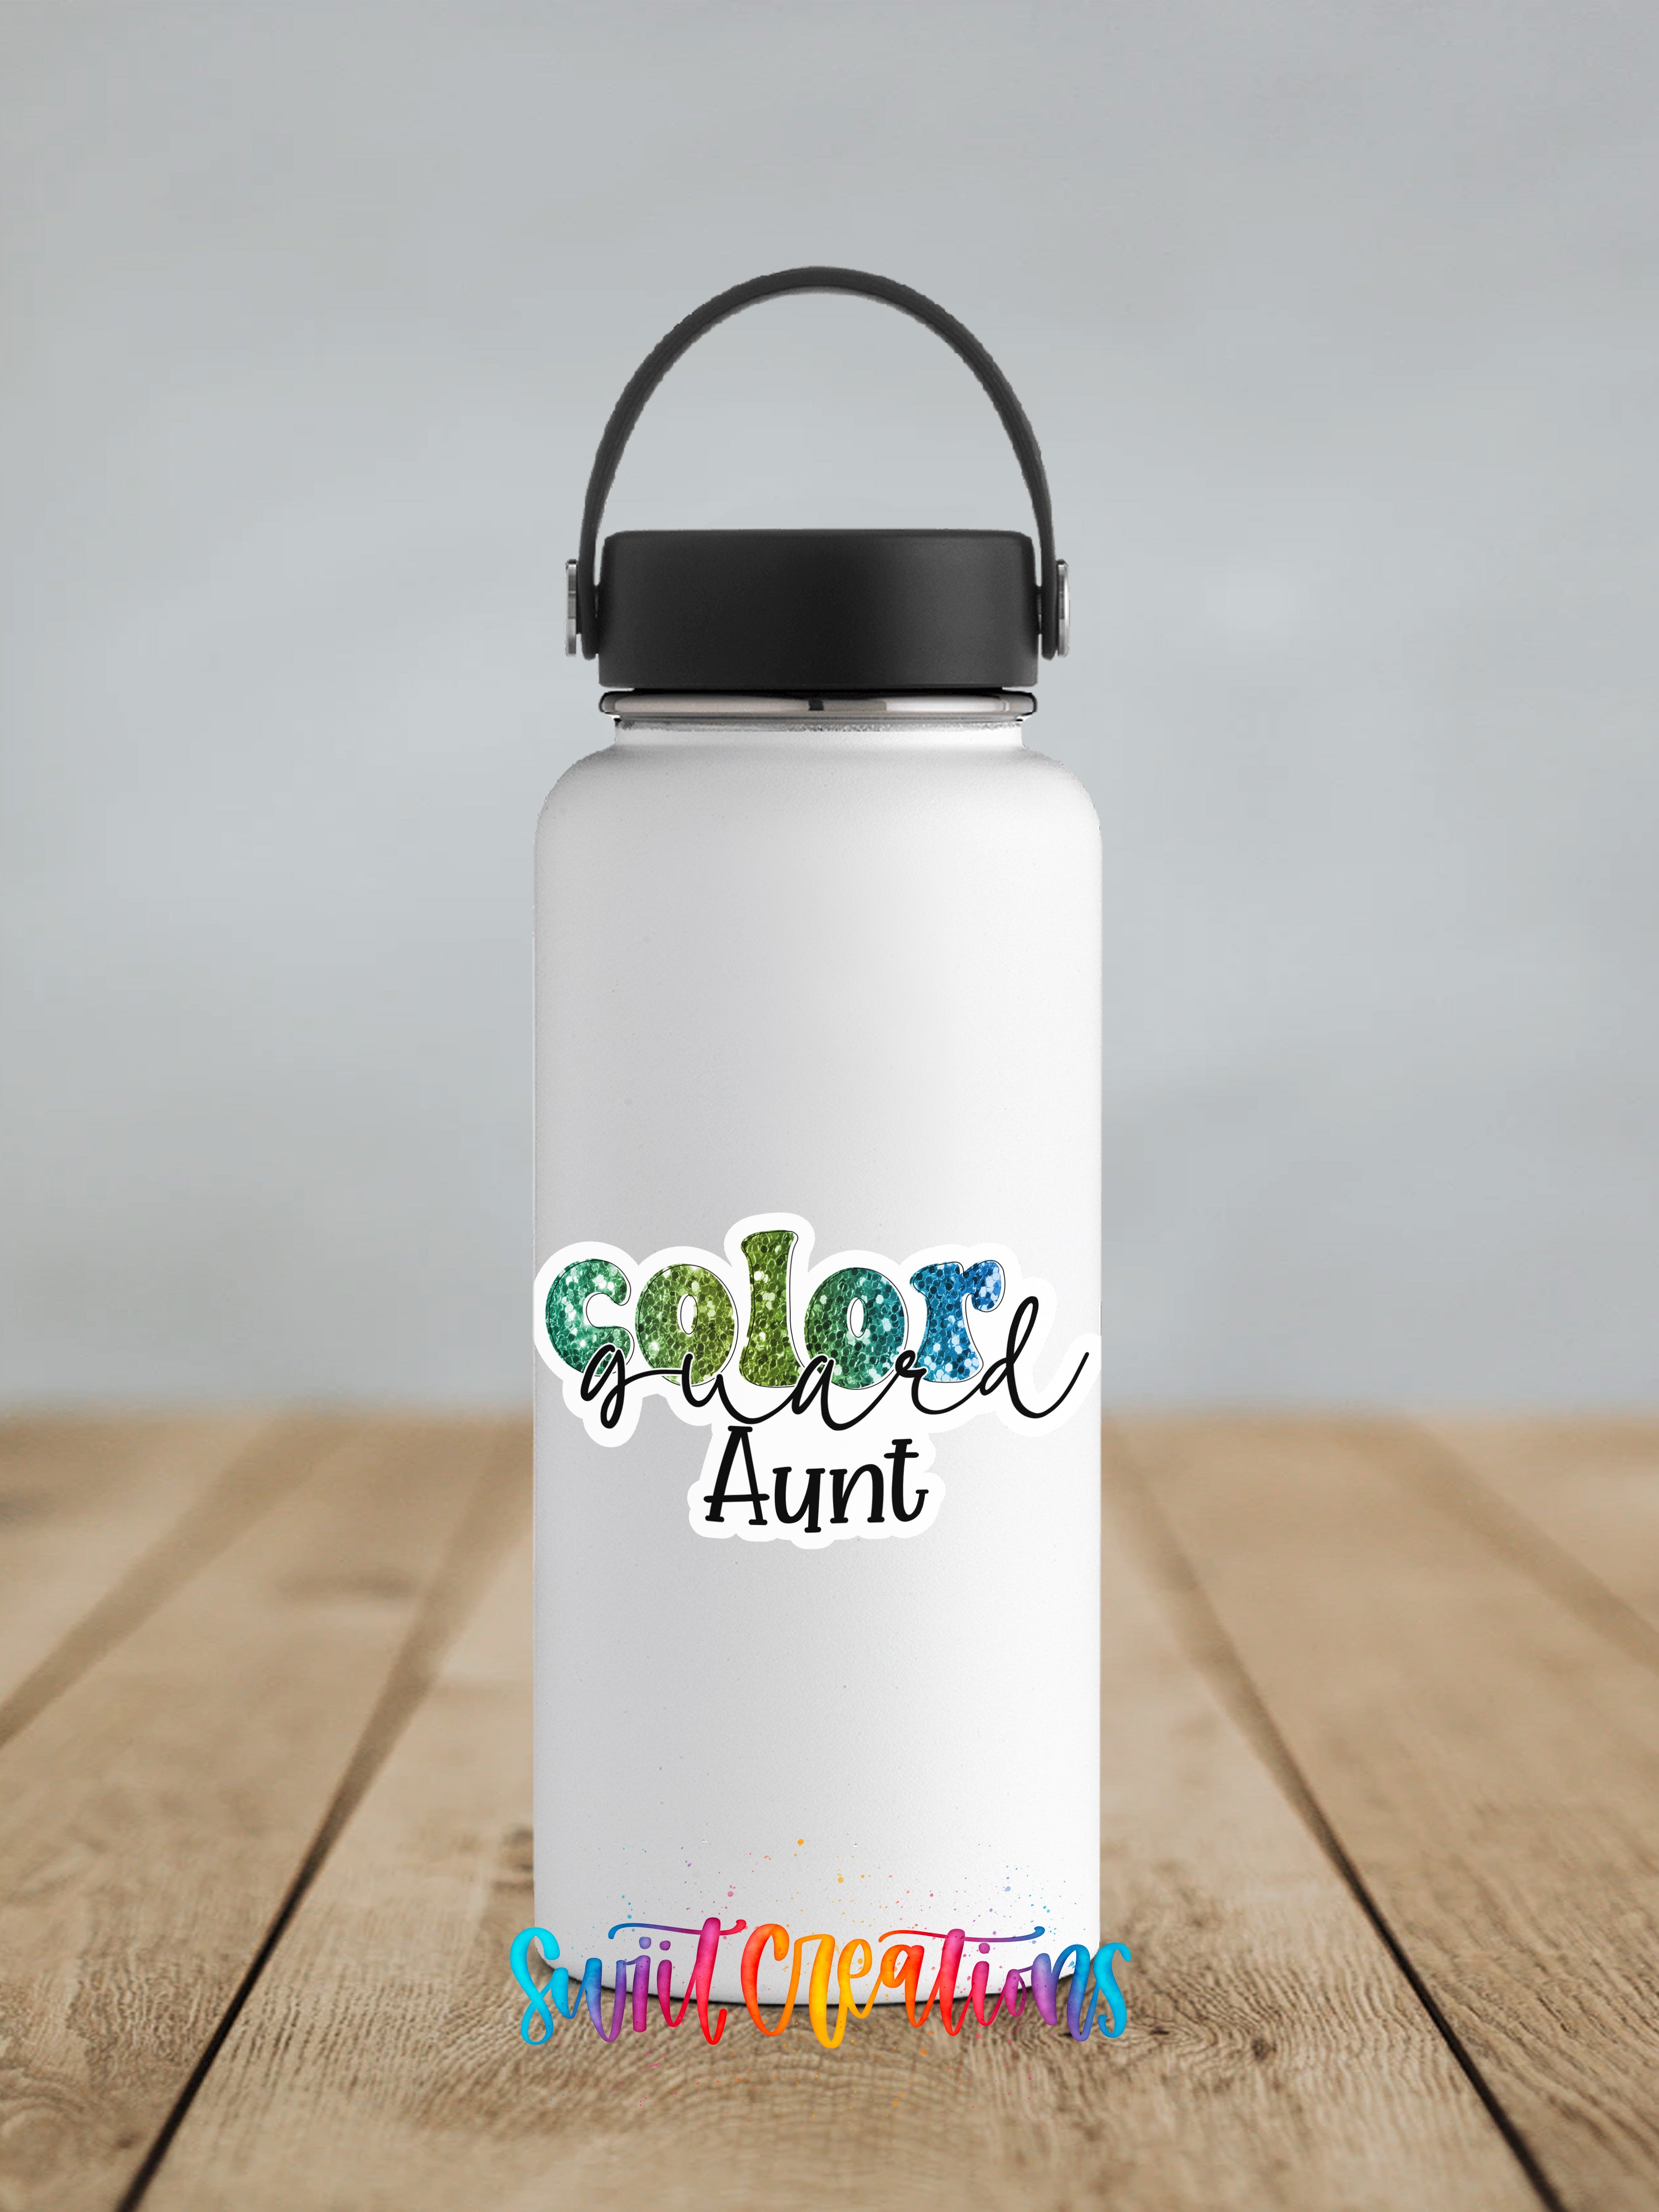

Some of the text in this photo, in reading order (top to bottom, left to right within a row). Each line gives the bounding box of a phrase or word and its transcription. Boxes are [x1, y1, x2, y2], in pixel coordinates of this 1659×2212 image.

[545, 1229, 1006, 1389] color
[580, 1296, 1089, 1430] guard
[703, 1426, 929, 1533] Aunt
